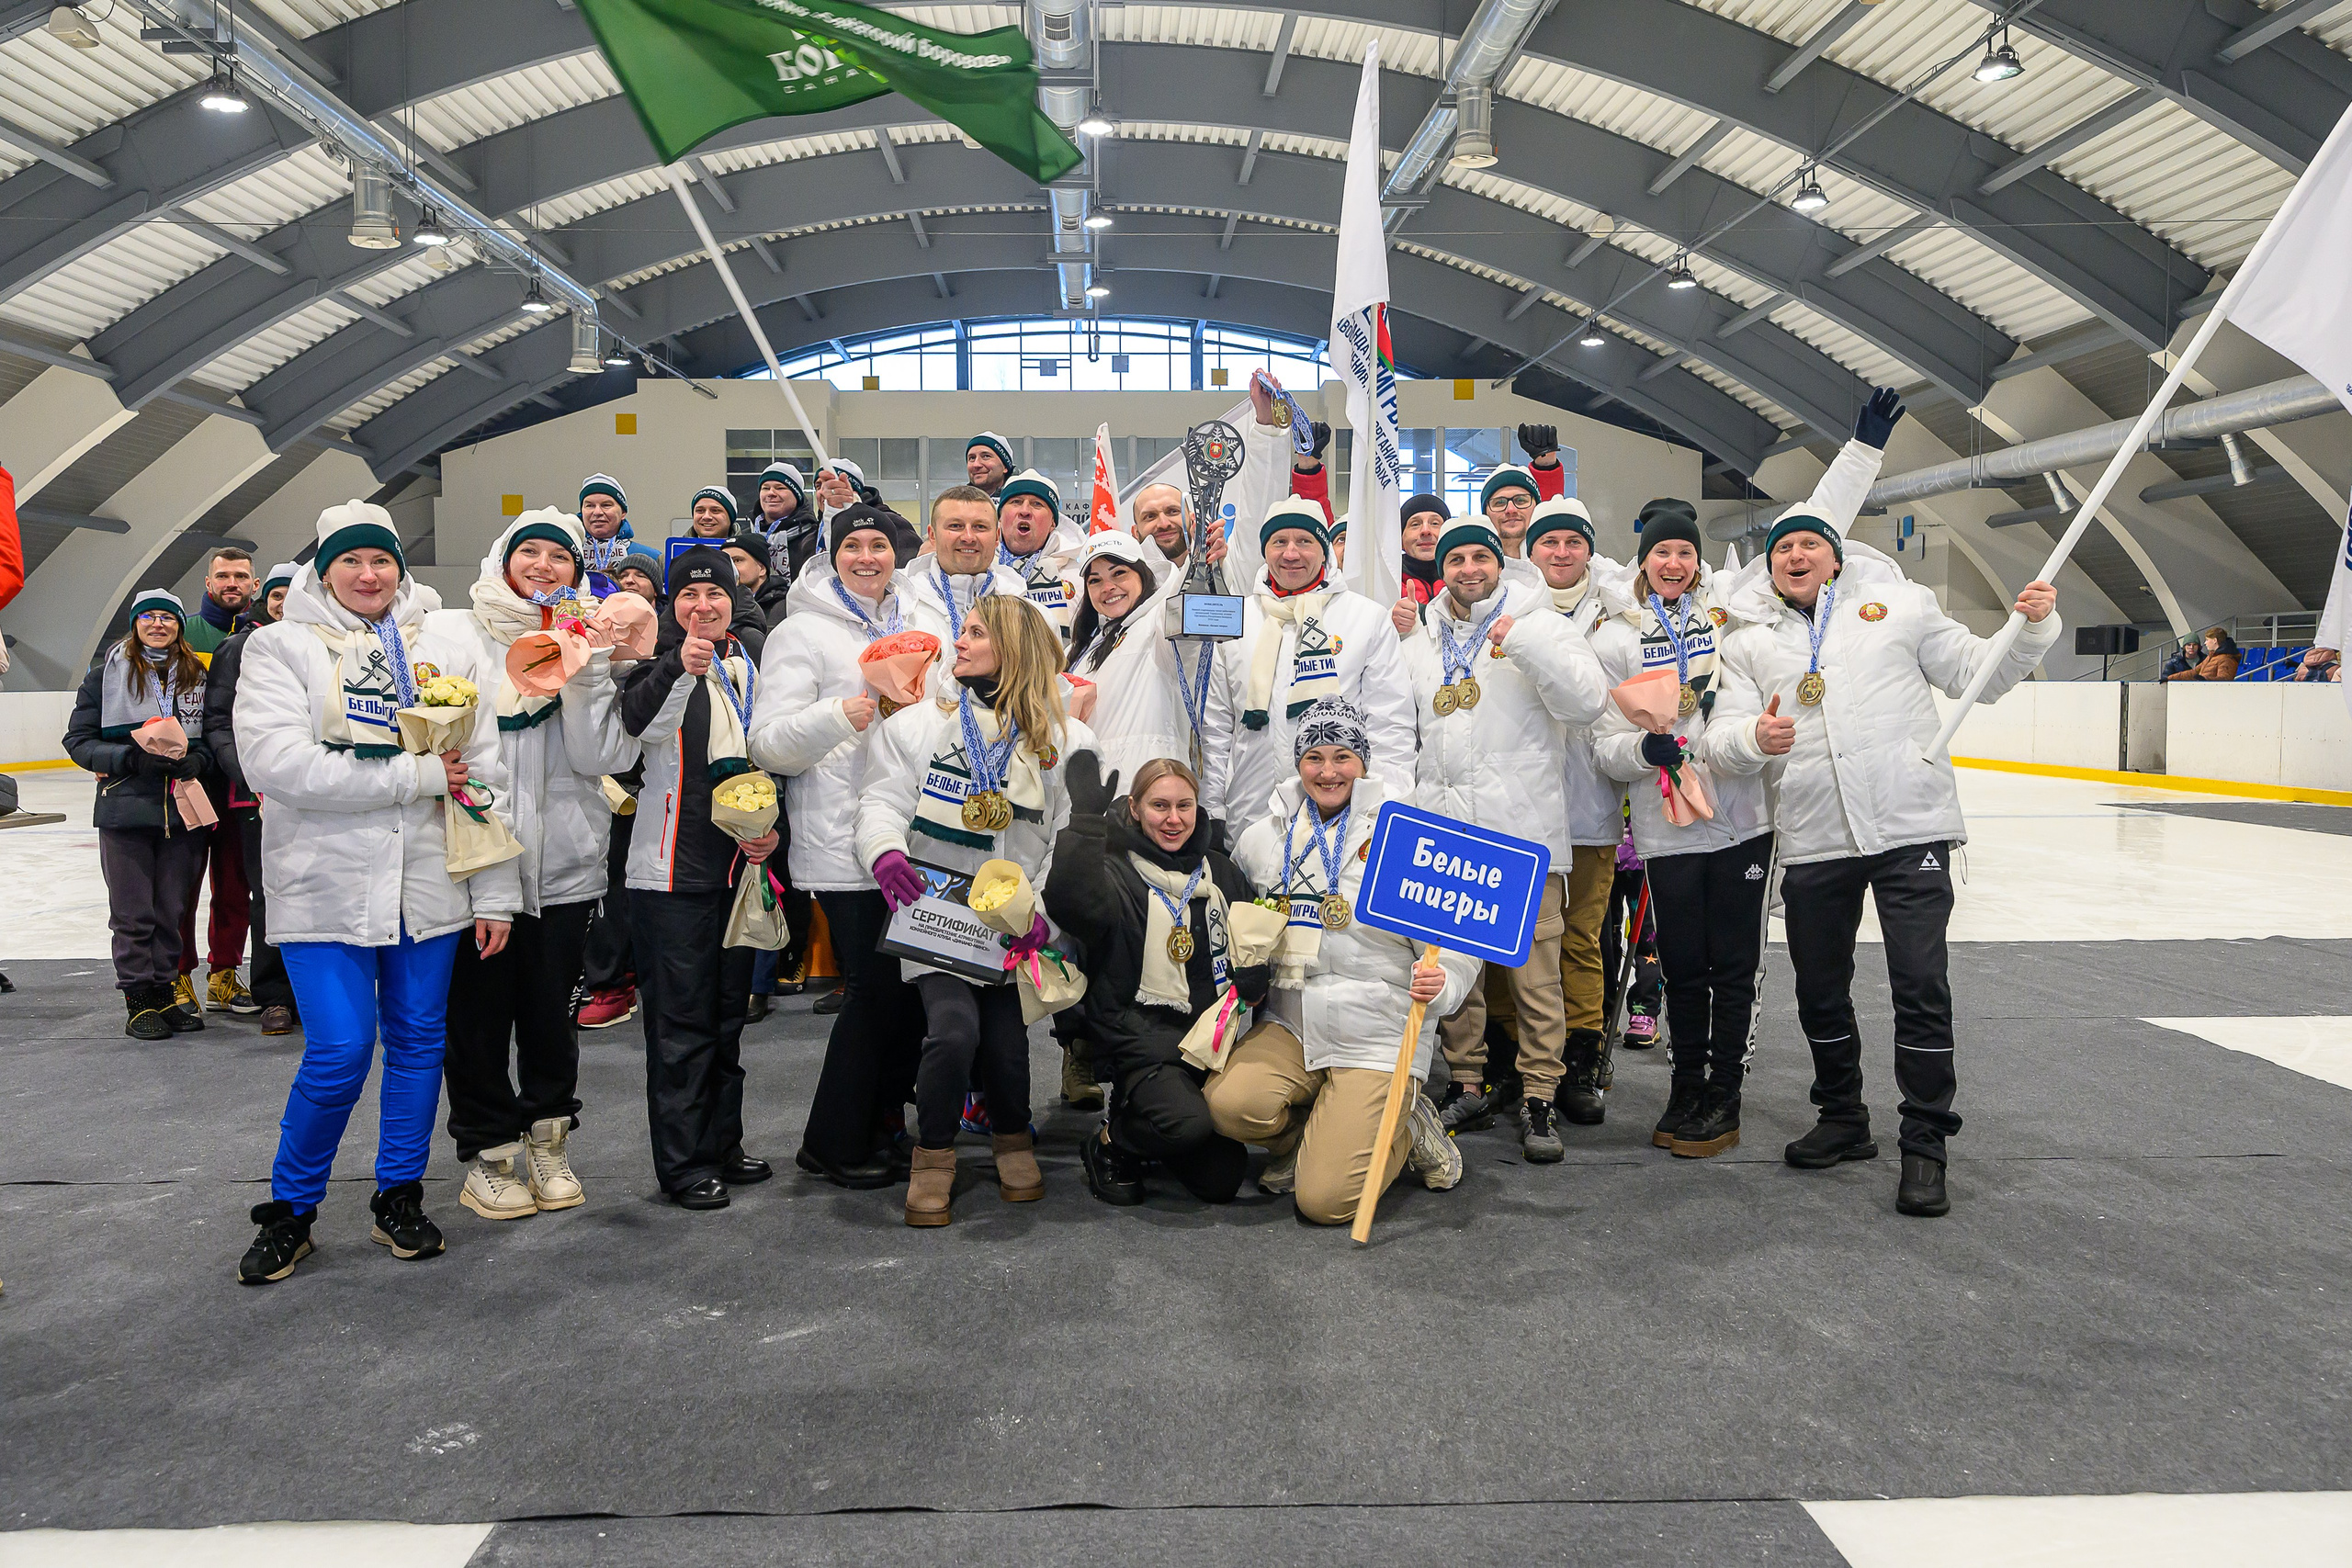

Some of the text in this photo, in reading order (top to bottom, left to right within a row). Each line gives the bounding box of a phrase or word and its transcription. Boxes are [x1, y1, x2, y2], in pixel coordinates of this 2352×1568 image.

[783, 68, 860, 95] САНА
[1066, 502, 1090, 511] КАФ
[1031, 590, 1063, 603] ТИГРЫ
[1686, 635, 1713, 651] ИГРЫ
[184, 692, 204, 707] ЕДИ
[347, 696, 386, 716] БЕЛЫ
[926, 772, 963, 795] БЕЛЫЕ
[1412, 836, 1503, 889] Белые
[1398, 877, 1500, 926] тигры
[911, 908, 998, 942] СЕРТИФИКАТ
